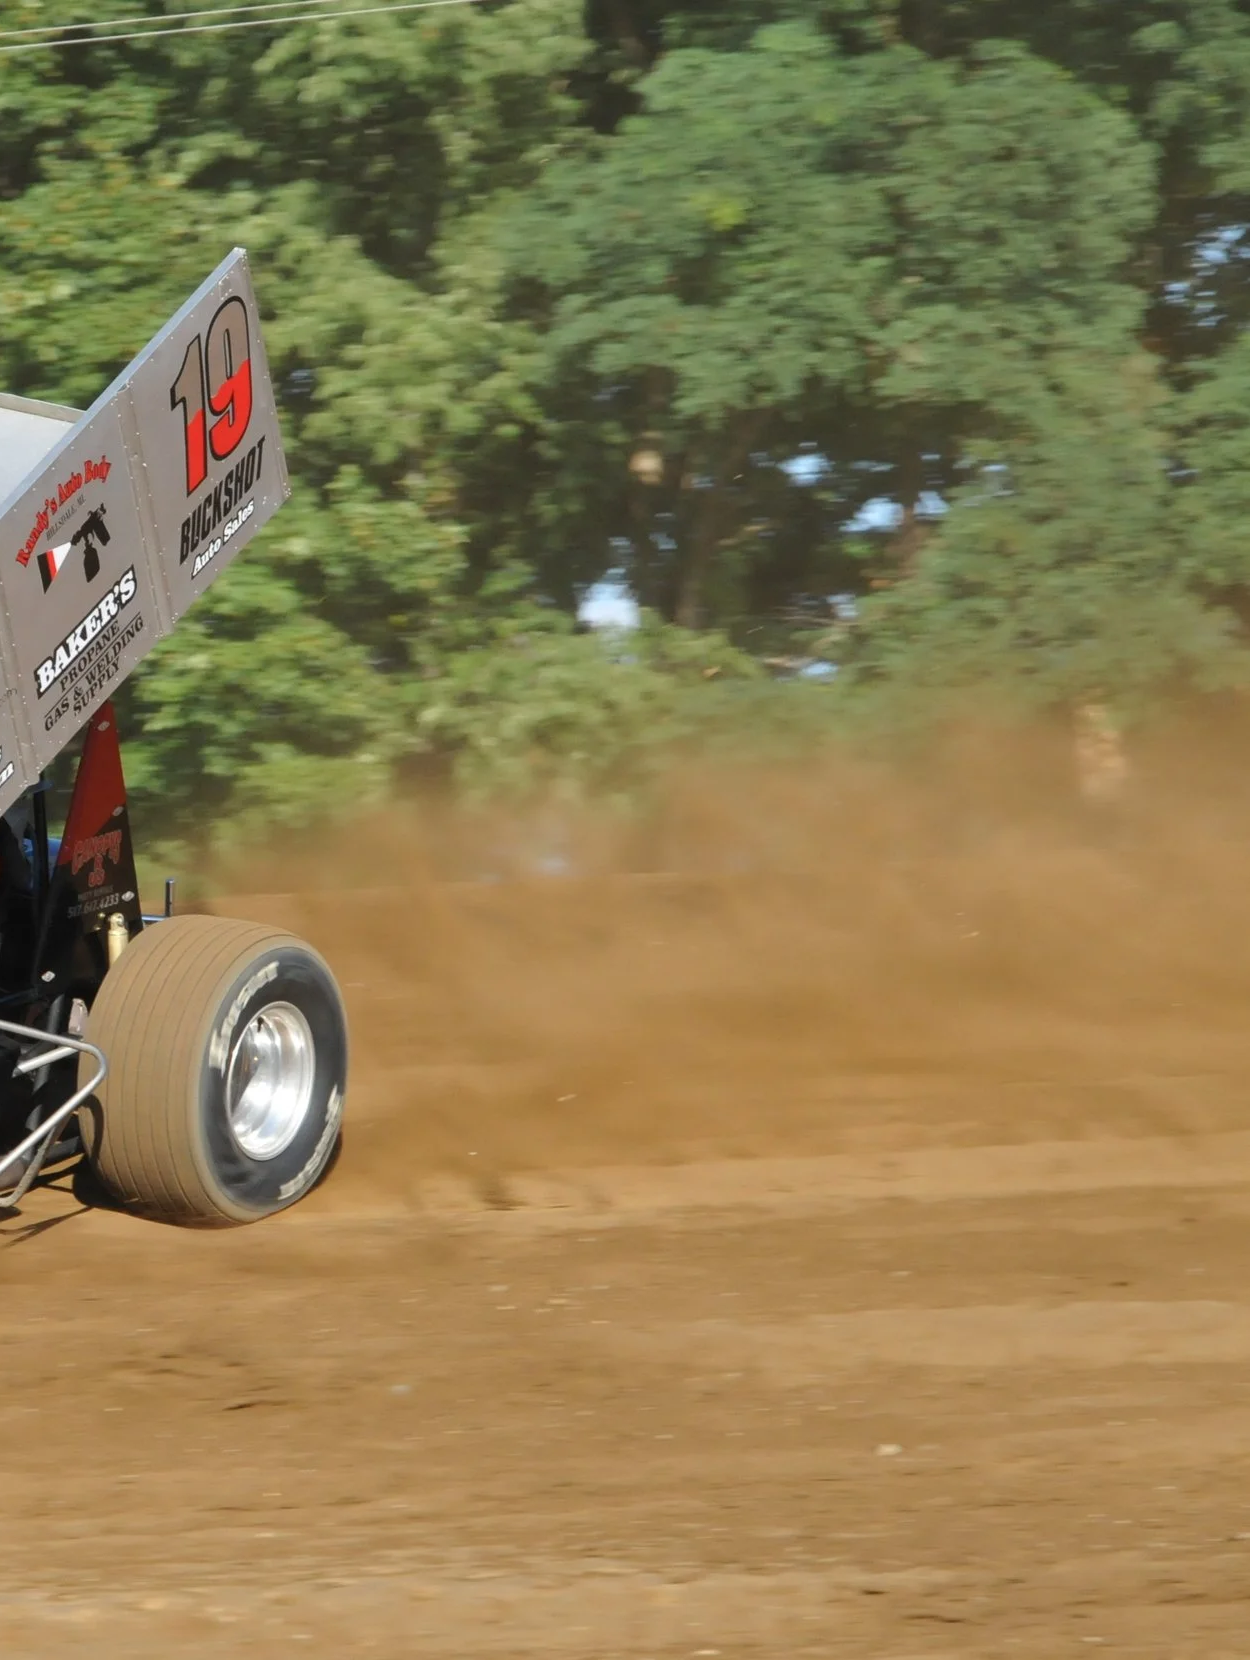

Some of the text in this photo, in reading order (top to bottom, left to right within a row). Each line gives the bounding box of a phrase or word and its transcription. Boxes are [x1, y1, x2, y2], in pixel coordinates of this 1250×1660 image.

[169, 295, 253, 498] 19
[15, 455, 112, 568] Randy's Auto Body
[178, 435, 267, 566] BUCKSHOT
[191, 498, 255, 580] Auto Sales
[34, 565, 137, 699] BAKER'S
[44, 616, 144, 731] GAS & WELDING
[59, 620, 120, 693] PROPANE
[73, 656, 121, 716] SUPPLY
